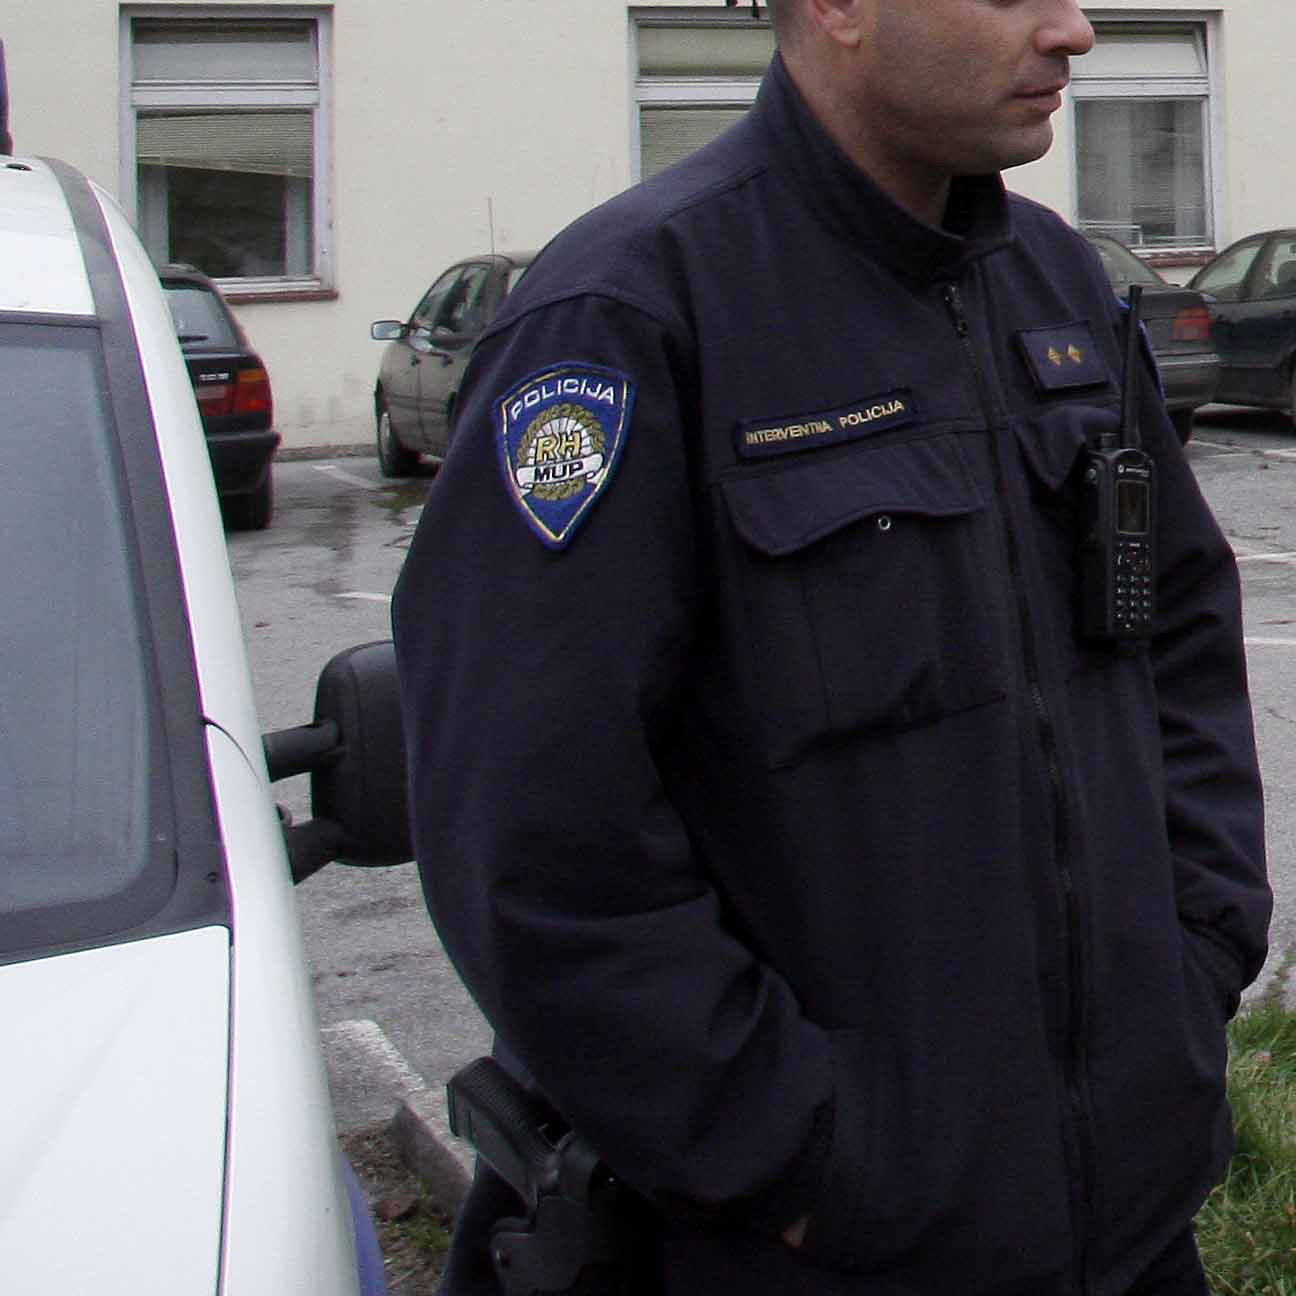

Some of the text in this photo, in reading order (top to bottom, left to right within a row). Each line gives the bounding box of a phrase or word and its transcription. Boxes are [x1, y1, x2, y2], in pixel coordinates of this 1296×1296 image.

[511, 378, 615, 420] POLICIJA
[839, 399, 905, 428] POLICIJA
[536, 430, 582, 462] RH
[534, 460, 584, 483] MUP
